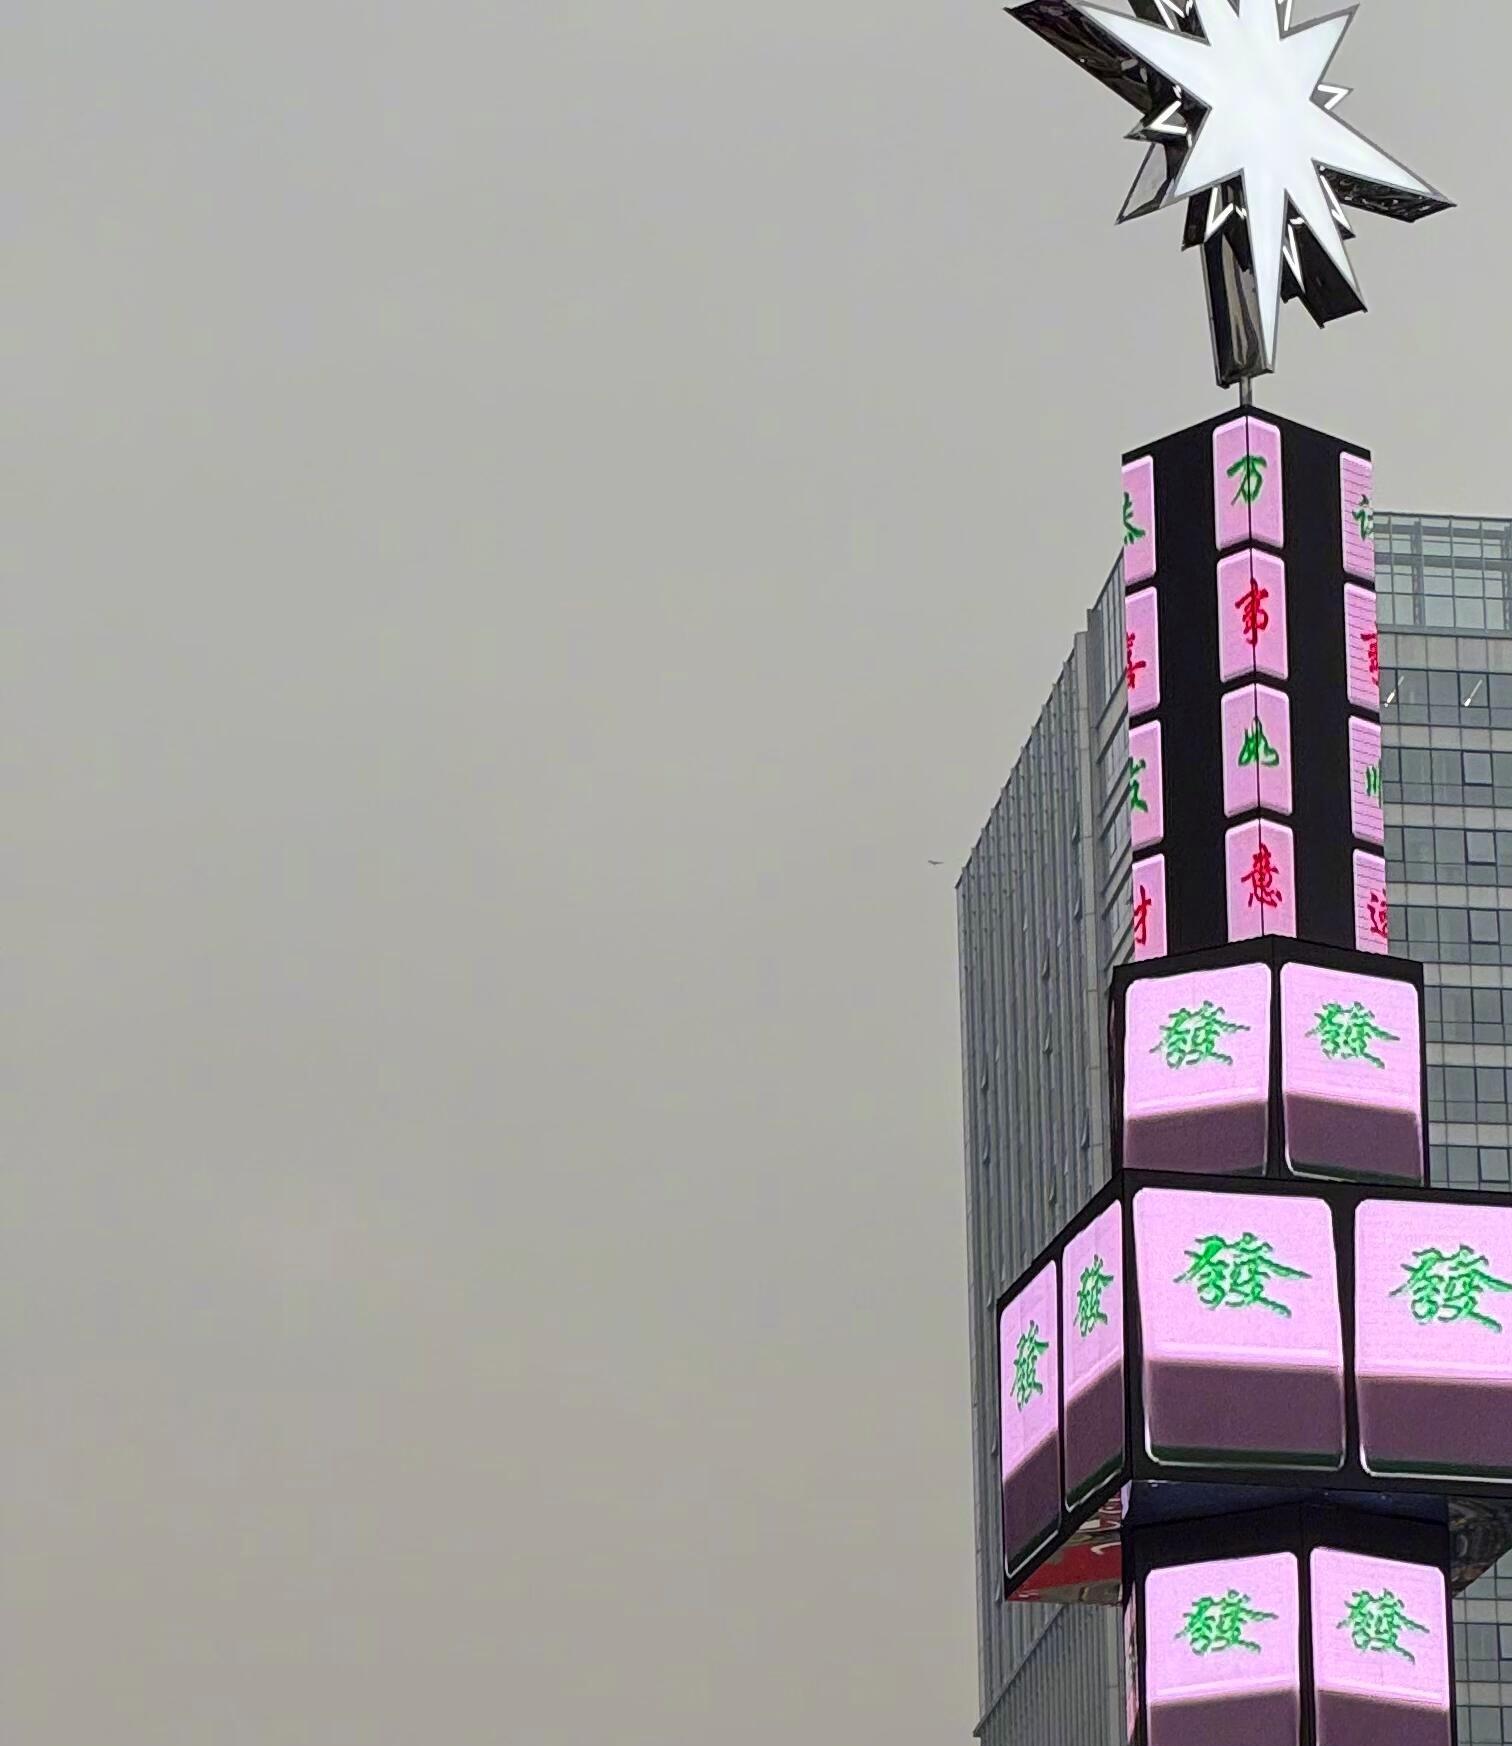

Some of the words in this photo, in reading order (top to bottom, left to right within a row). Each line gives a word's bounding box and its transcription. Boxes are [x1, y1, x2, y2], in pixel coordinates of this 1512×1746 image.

[1155, 1000, 1245, 1070] 發
[1310, 1001, 1397, 1070] 發
[1174, 1231, 1309, 1319] 發
[1176, 1589, 1275, 1657] 發
[1339, 1588, 1429, 1661] 發
